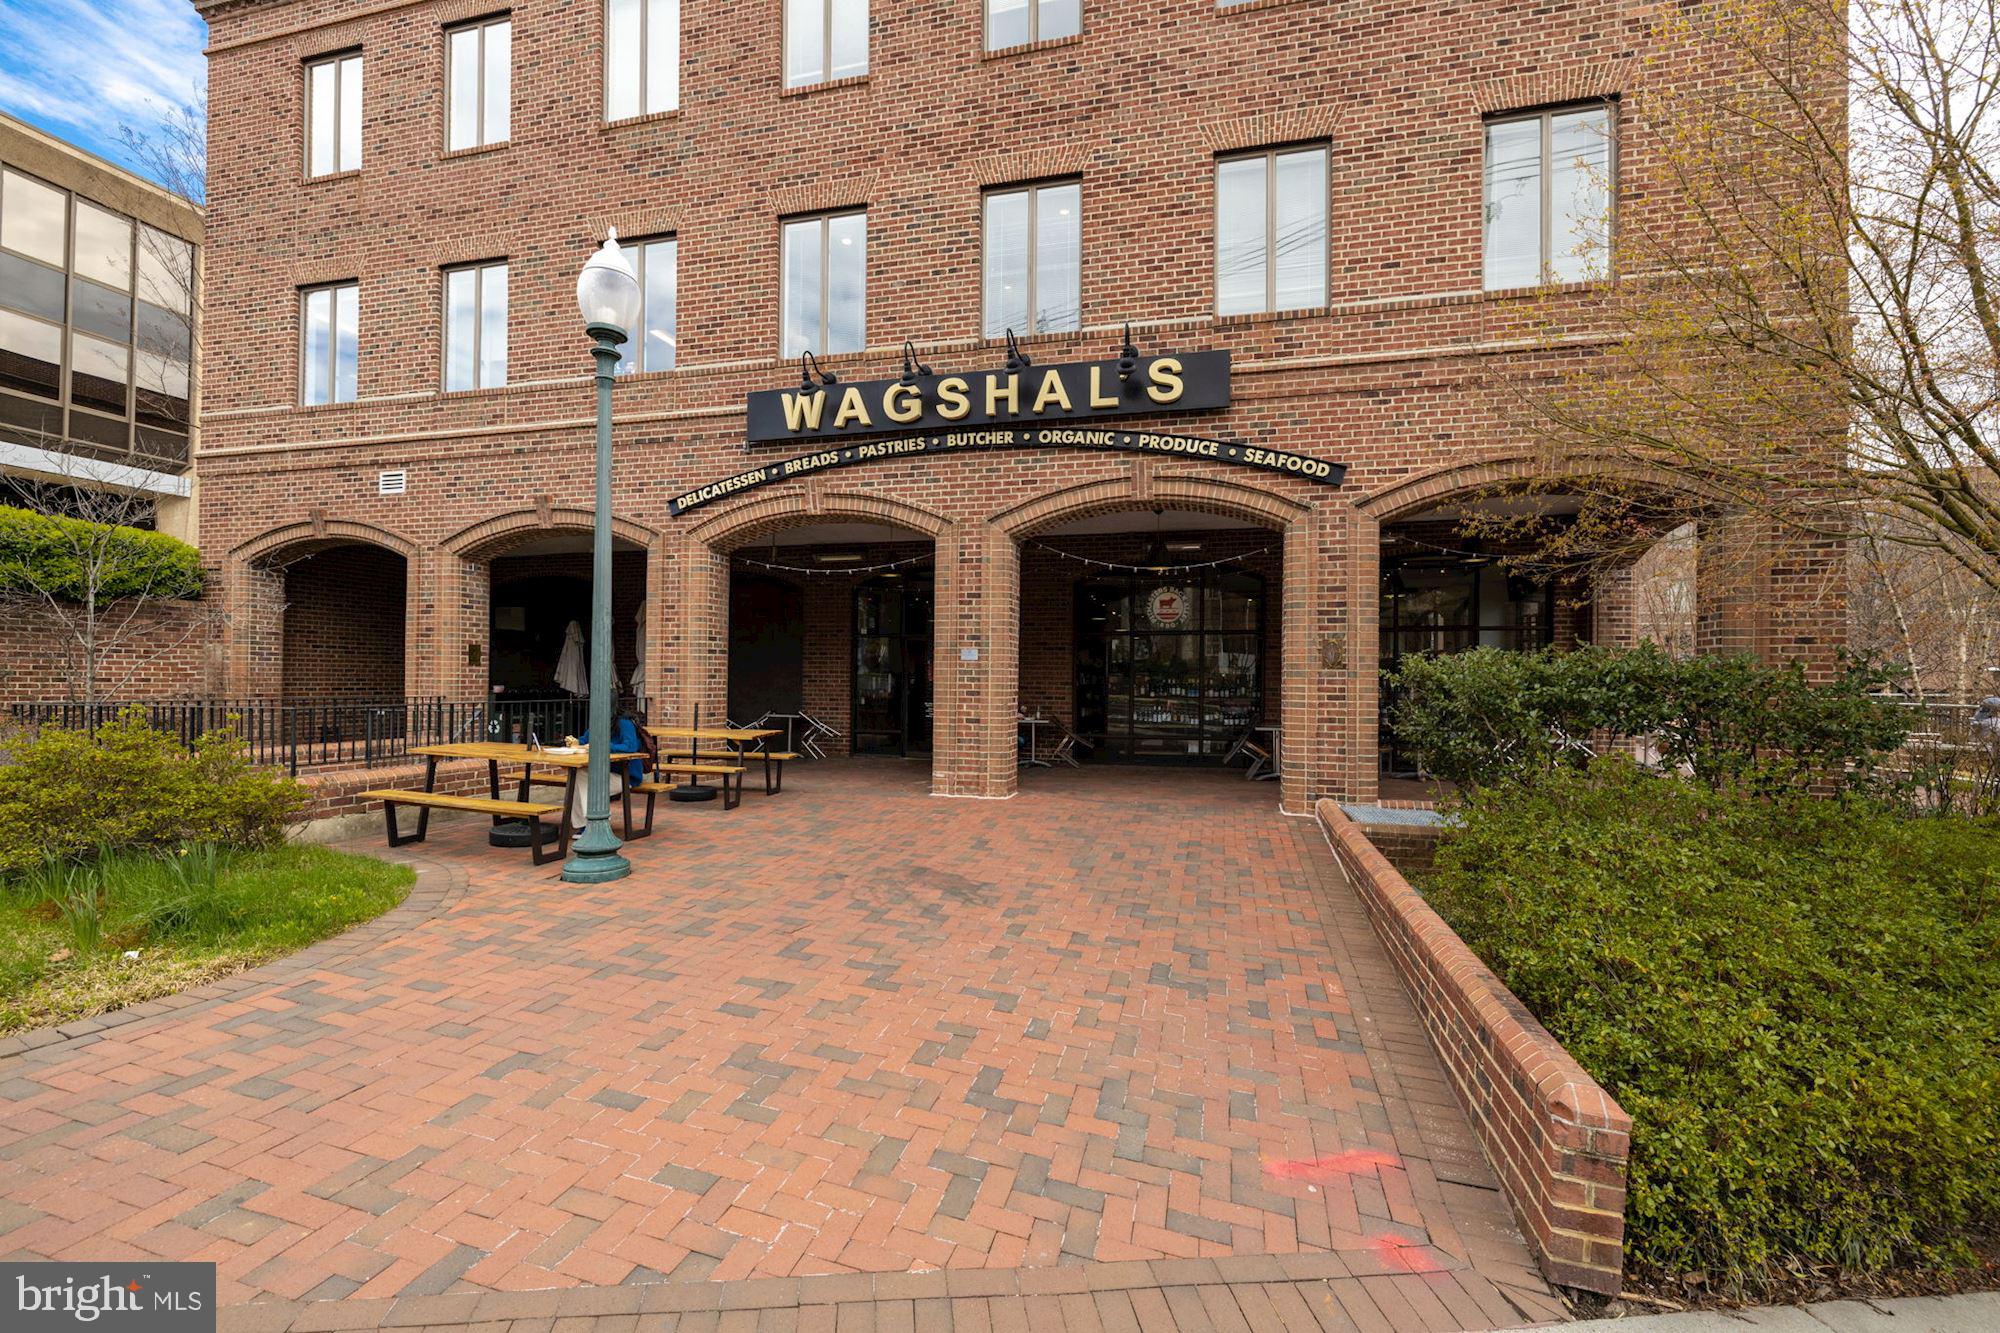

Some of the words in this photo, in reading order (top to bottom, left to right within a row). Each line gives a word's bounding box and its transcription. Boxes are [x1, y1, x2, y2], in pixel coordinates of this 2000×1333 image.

[676, 468, 767, 511] DELICATESSEN
[784, 450, 840, 474] BREADS
[858, 436, 926, 458] PASTRIES
[946, 430, 1014, 447] BUTCHER
[1038, 429, 1115, 446] ORGANIC
[1138, 434, 1219, 457] PRODUCE
[1243, 447, 1331, 479] SEAFOOD
